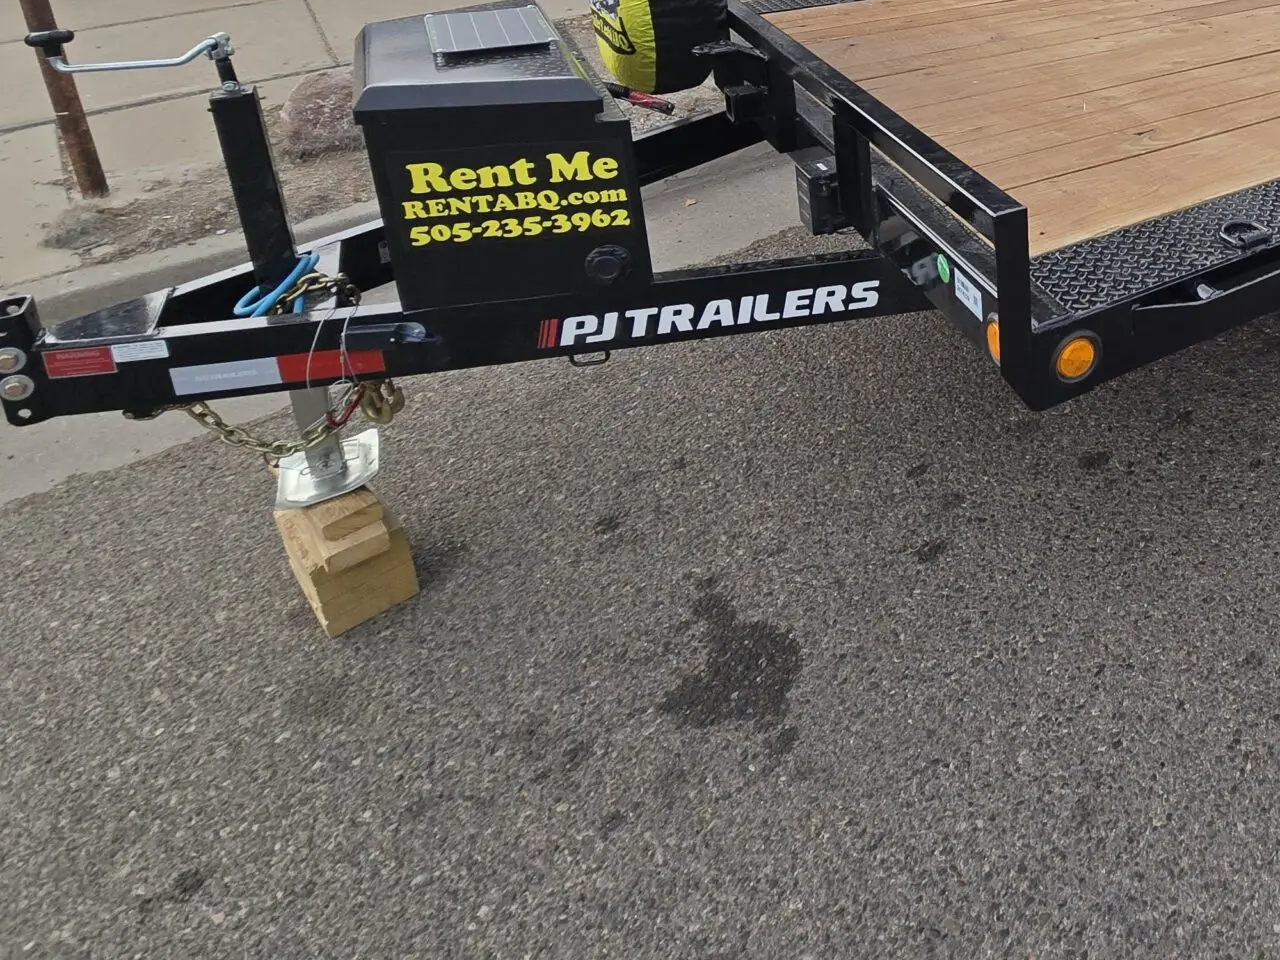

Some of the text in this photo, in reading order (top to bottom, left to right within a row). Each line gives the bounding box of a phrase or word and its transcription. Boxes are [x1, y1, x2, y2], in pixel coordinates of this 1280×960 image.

[405, 151, 619, 194] Rent Me
[401, 188, 628, 220] RENTABQ.com
[409, 209, 630, 247] 505-235-3962
[624, 280, 881, 338] TRAILERS
